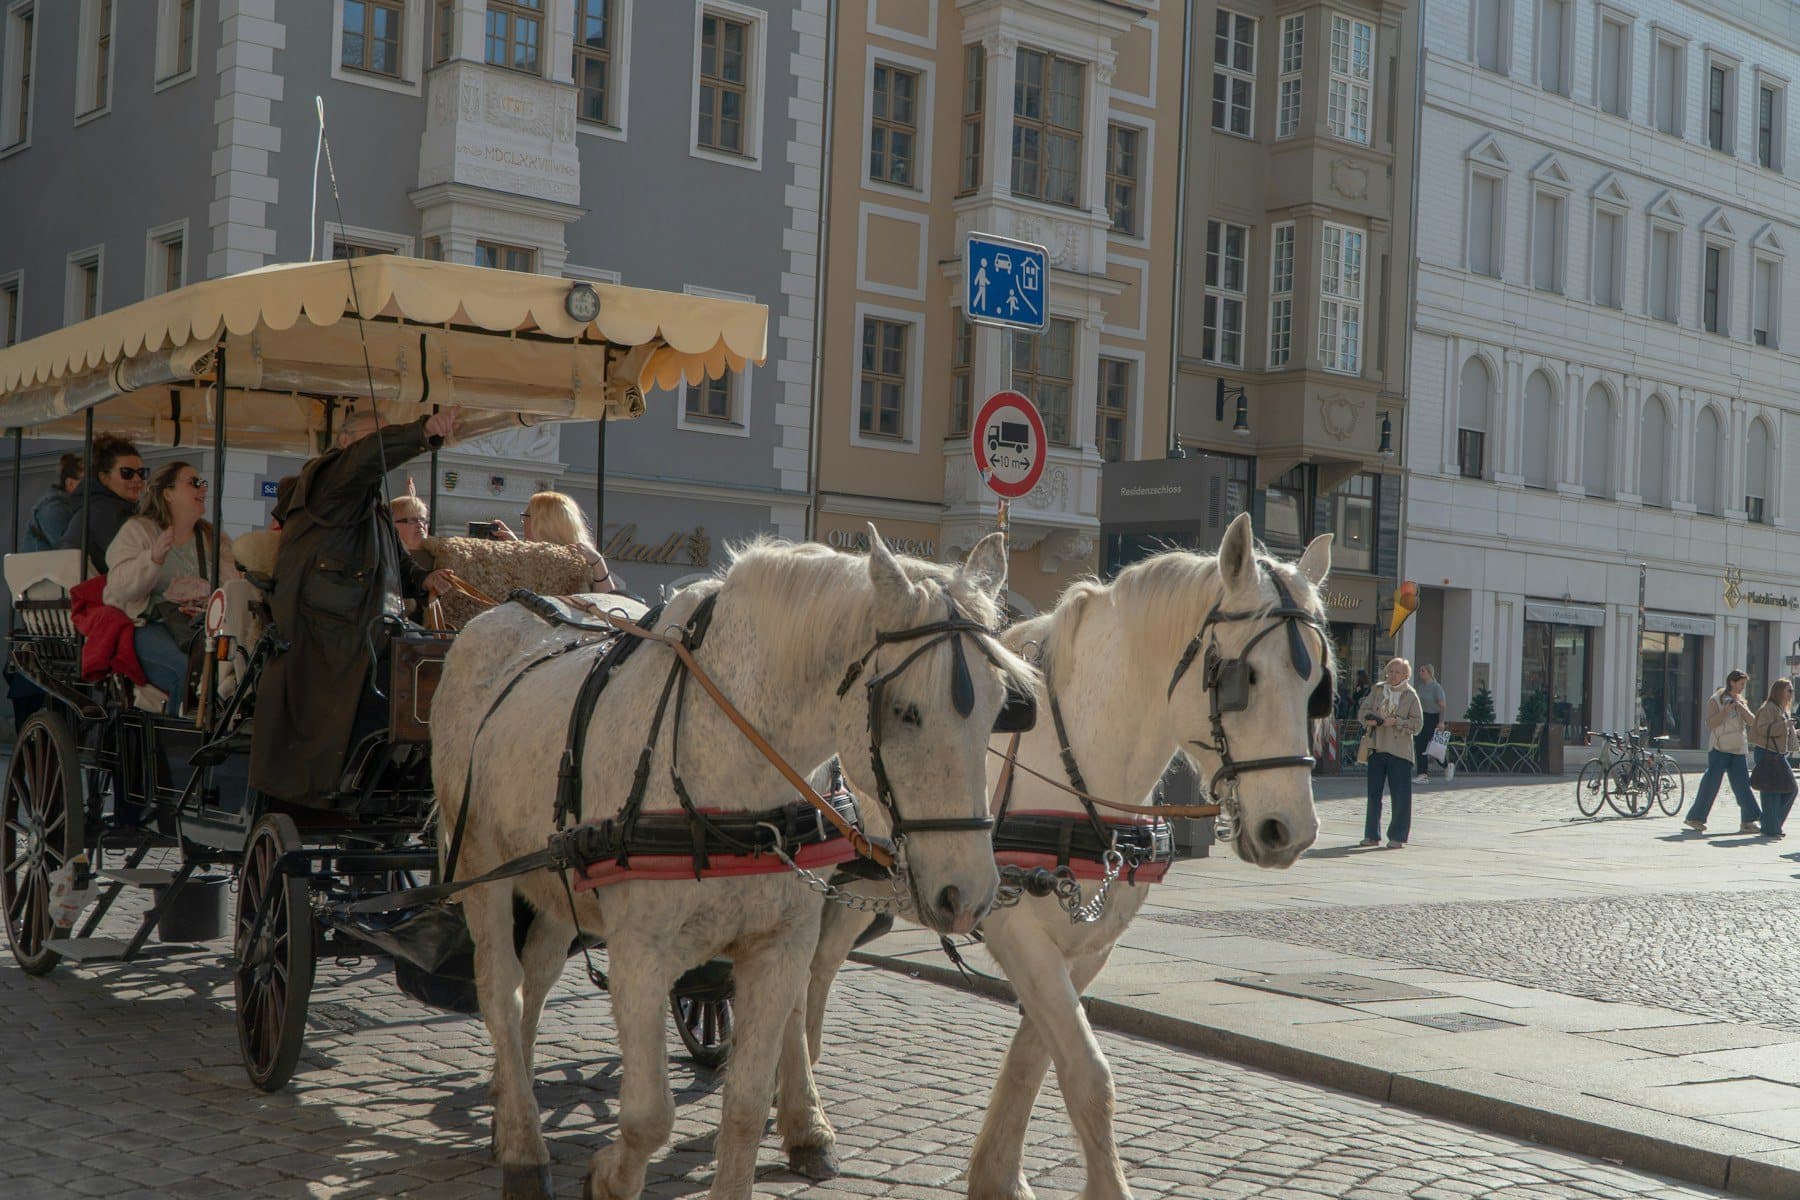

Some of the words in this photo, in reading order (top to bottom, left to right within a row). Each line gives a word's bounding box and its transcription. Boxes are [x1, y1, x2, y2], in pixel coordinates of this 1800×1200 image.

[1001, 456, 1010, 468] 10
[1012, 459, 1020, 470] m
[264, 484, 277, 493] Sch
[1120, 484, 1182, 497] Residenzschloss
[1747, 592, 1787, 608] Platzhirsch
